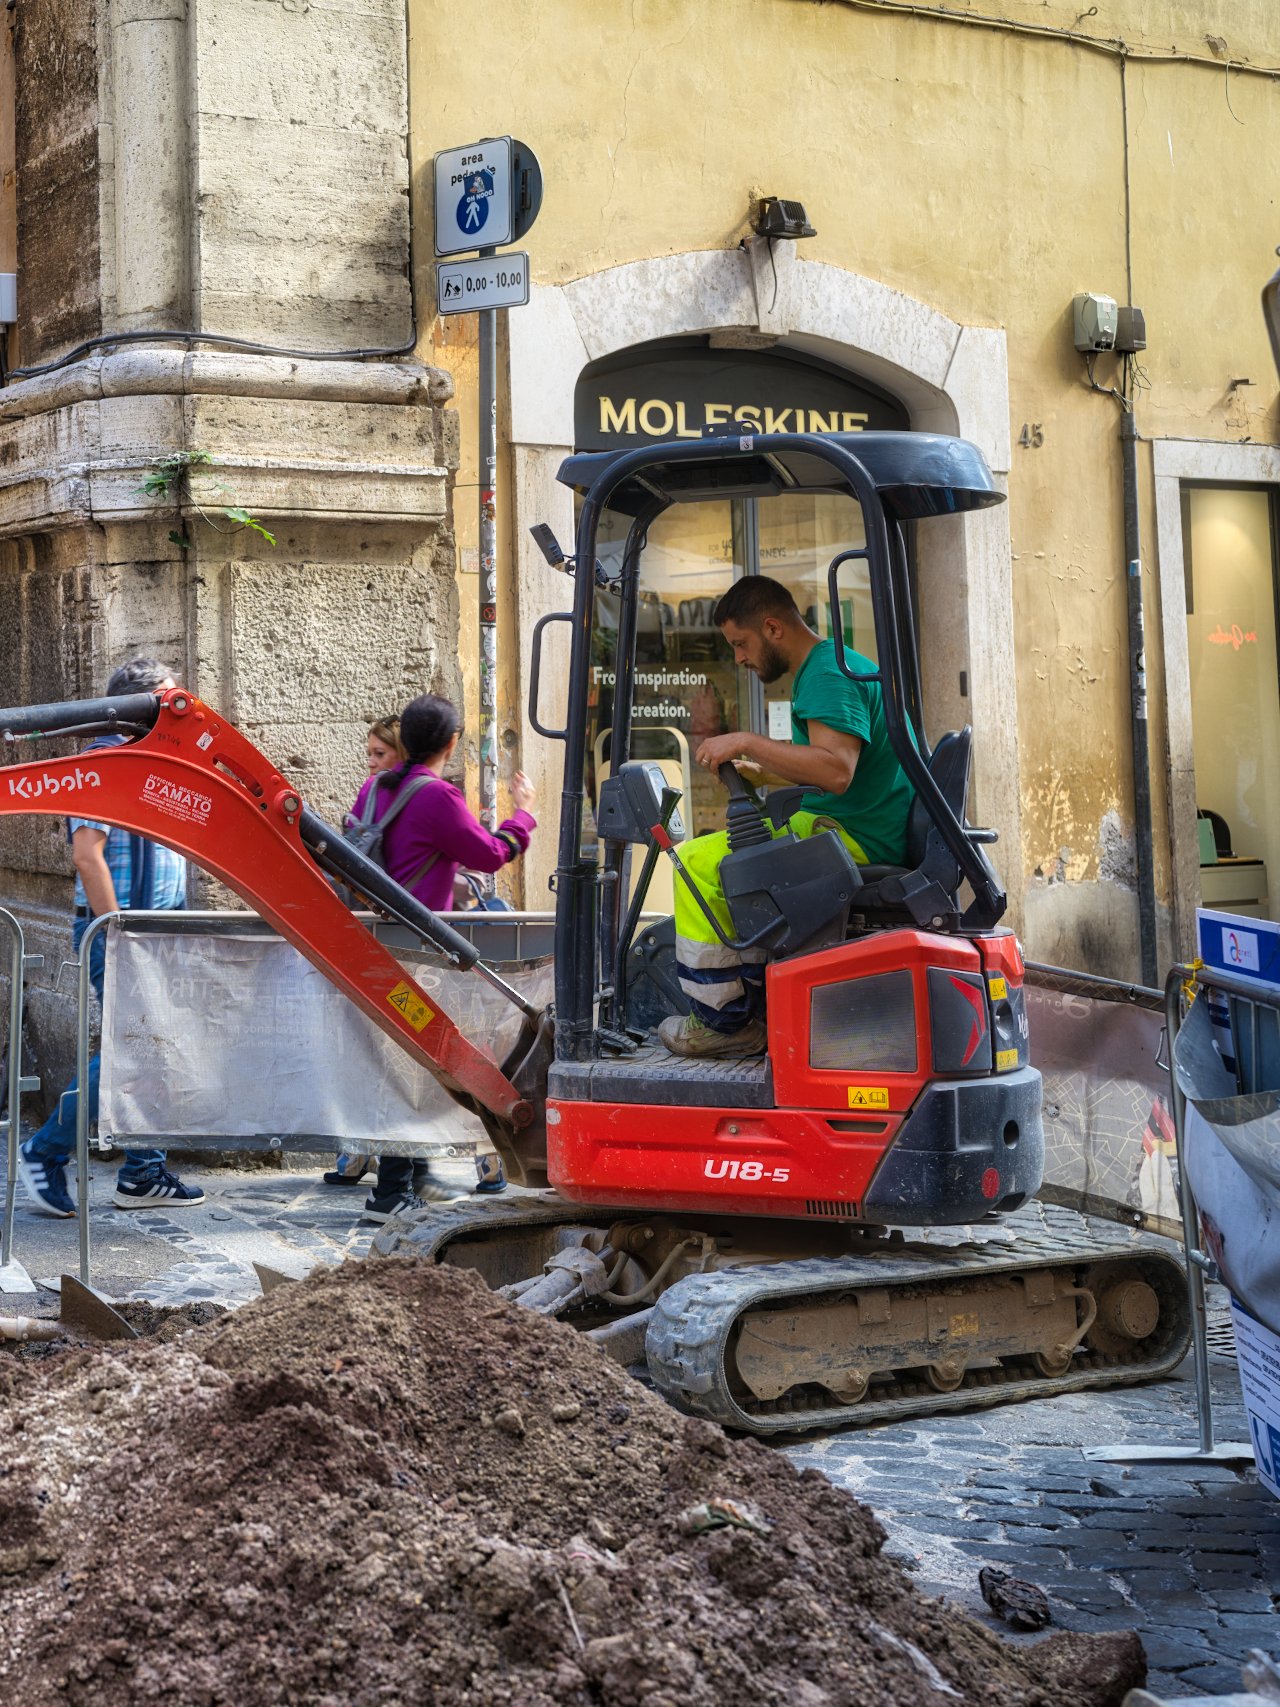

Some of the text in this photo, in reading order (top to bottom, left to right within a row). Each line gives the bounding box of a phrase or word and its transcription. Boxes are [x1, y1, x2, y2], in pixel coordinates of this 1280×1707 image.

[461, 153, 484, 166] area
[451, 165, 496, 187] pede
[466, 189, 493, 203] OH NOOO
[466, 276, 487, 293] 0,00
[496, 271, 522, 288] 10,00
[1018, 423, 1044, 449] 45
[593, 666, 707, 692] Fro inspiration
[631, 699, 691, 718] creation.
[8, 767, 101, 799] Kubota
[149, 774, 212, 803] OFFICINA MECCANICA
[704, 1160, 790, 1182] U18-5
